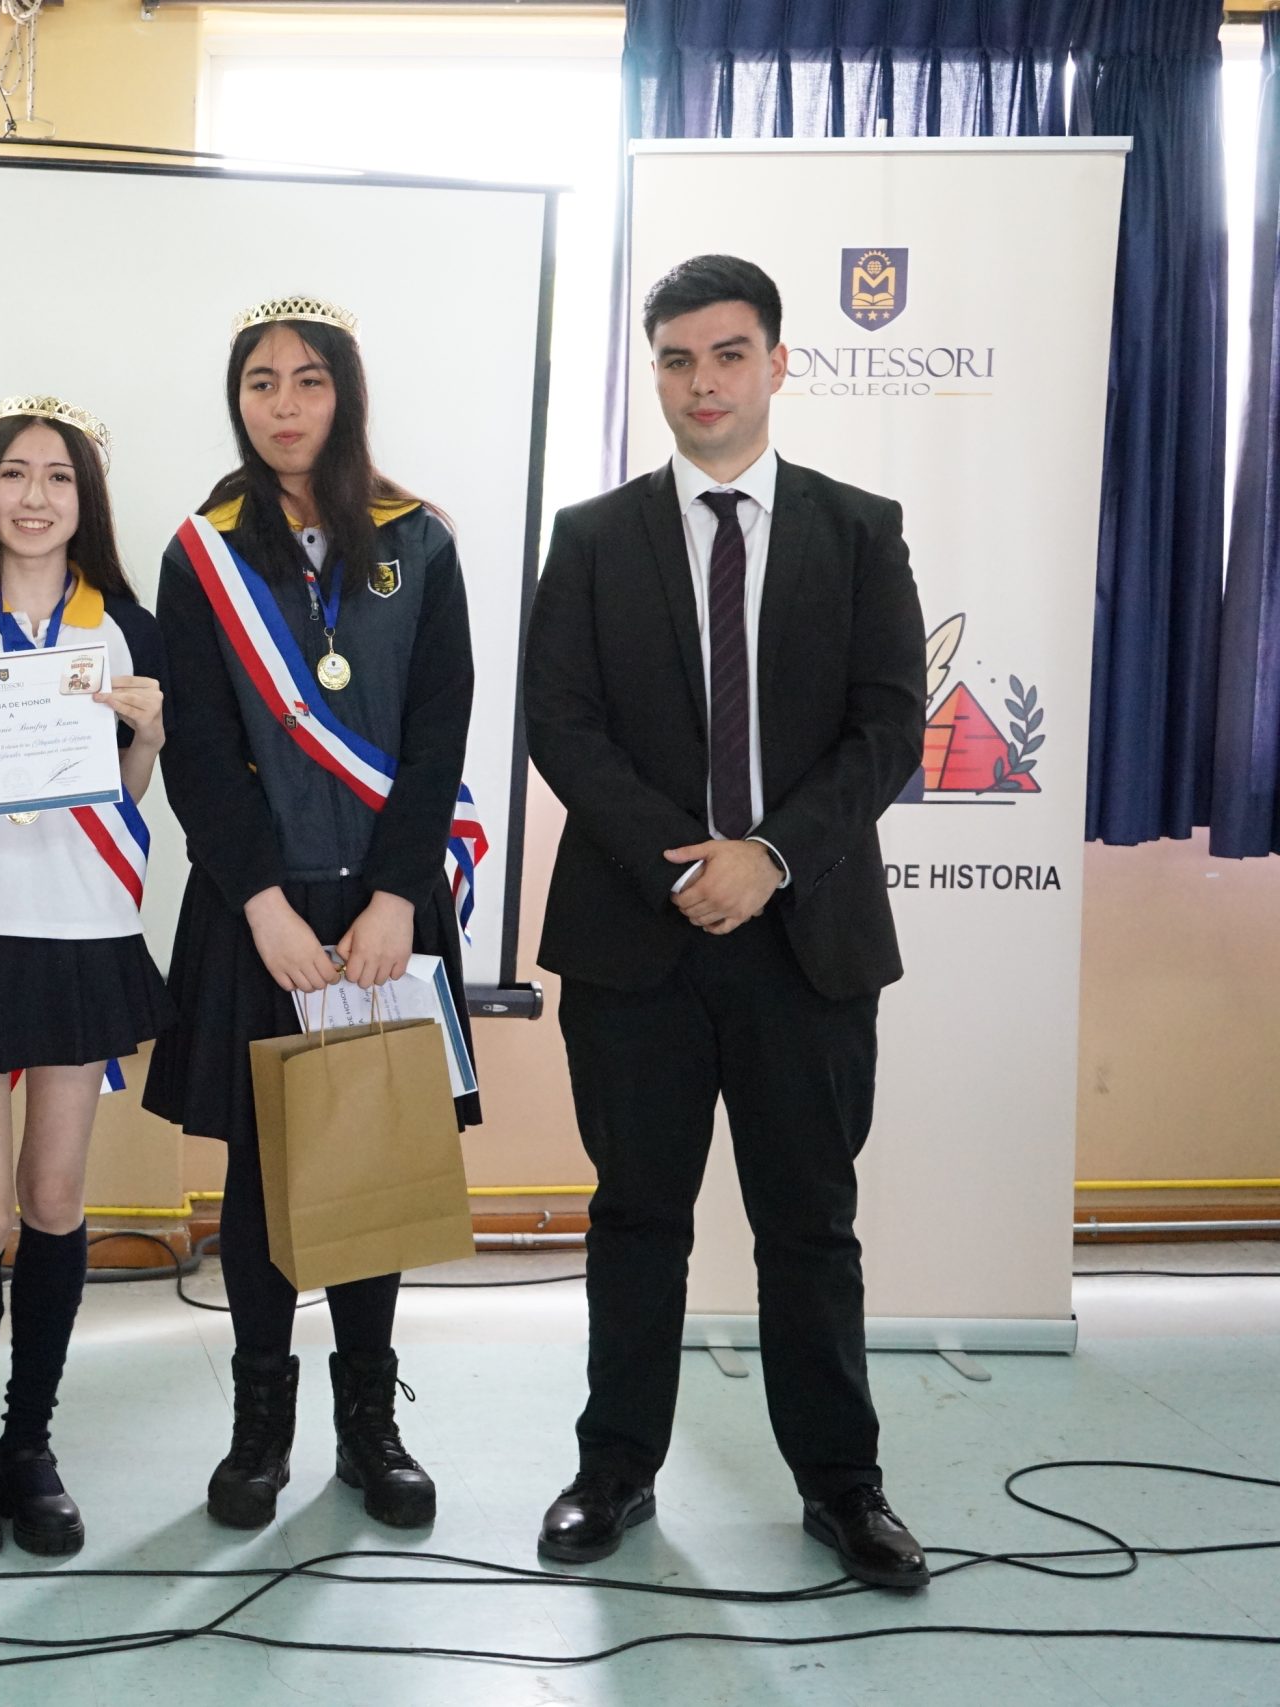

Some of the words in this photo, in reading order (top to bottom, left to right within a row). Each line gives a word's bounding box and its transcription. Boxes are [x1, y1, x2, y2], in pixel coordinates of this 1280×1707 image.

[786, 347, 995, 378] ONTESSORI
[809, 382, 931, 396] COLEGIO
[22, 698, 51, 706] HONOR
[885, 863, 920, 888] DE
[930, 864, 1061, 890] HISTORIA
[339, 987, 351, 1015] HONOR
[347, 1016, 355, 1026] DE
